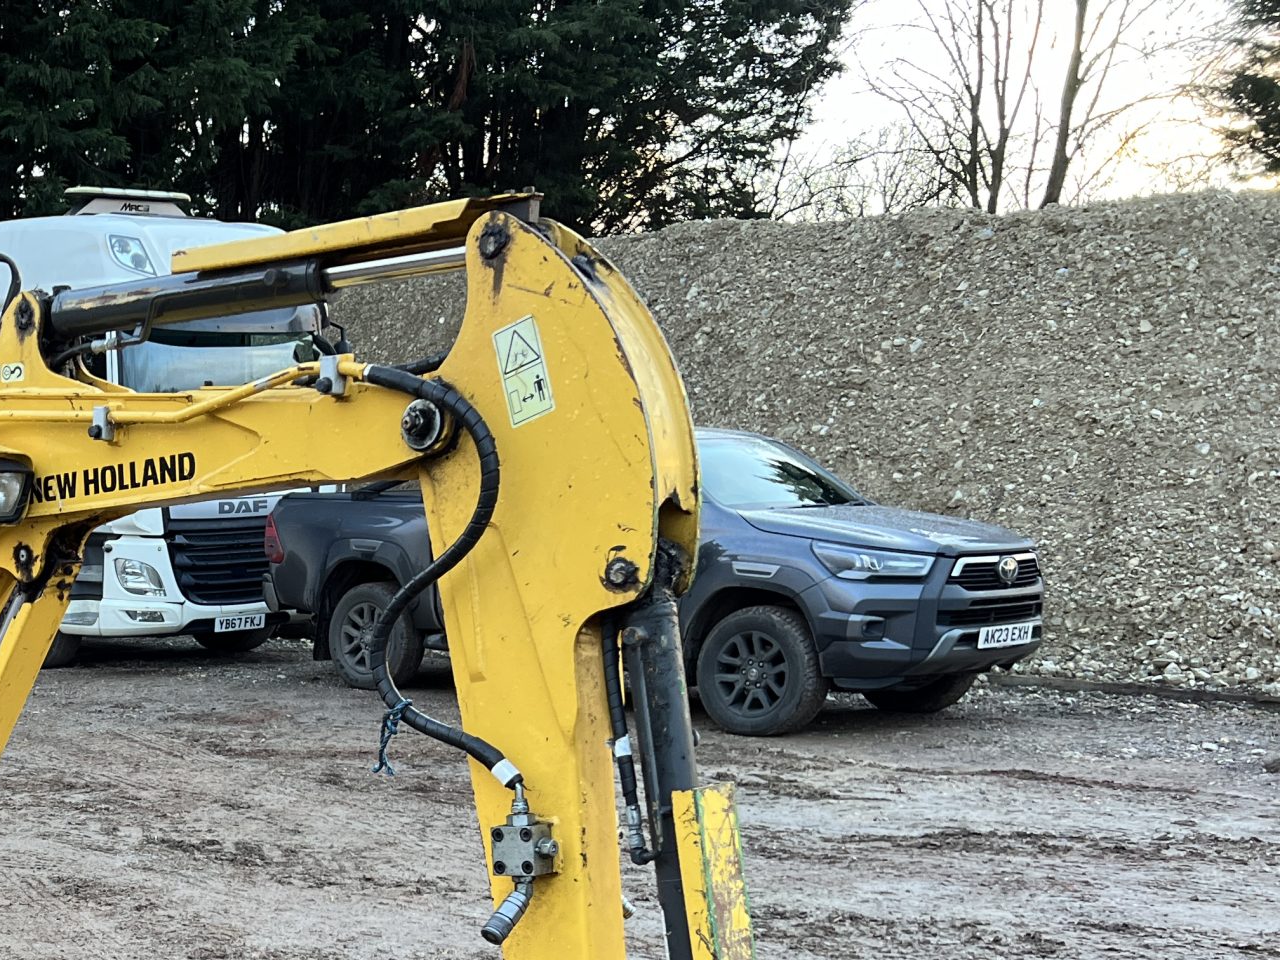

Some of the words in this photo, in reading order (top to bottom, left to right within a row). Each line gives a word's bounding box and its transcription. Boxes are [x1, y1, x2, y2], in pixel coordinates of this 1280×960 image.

[29, 471, 77, 504] NEW
[83, 452, 196, 496] HOLLAND
[218, 499, 268, 514] DAF
[219, 617, 243, 630] YB67
[244, 615, 262, 627] FKJ
[983, 627, 1009, 645] AK23
[1010, 625, 1030, 641] EXH
